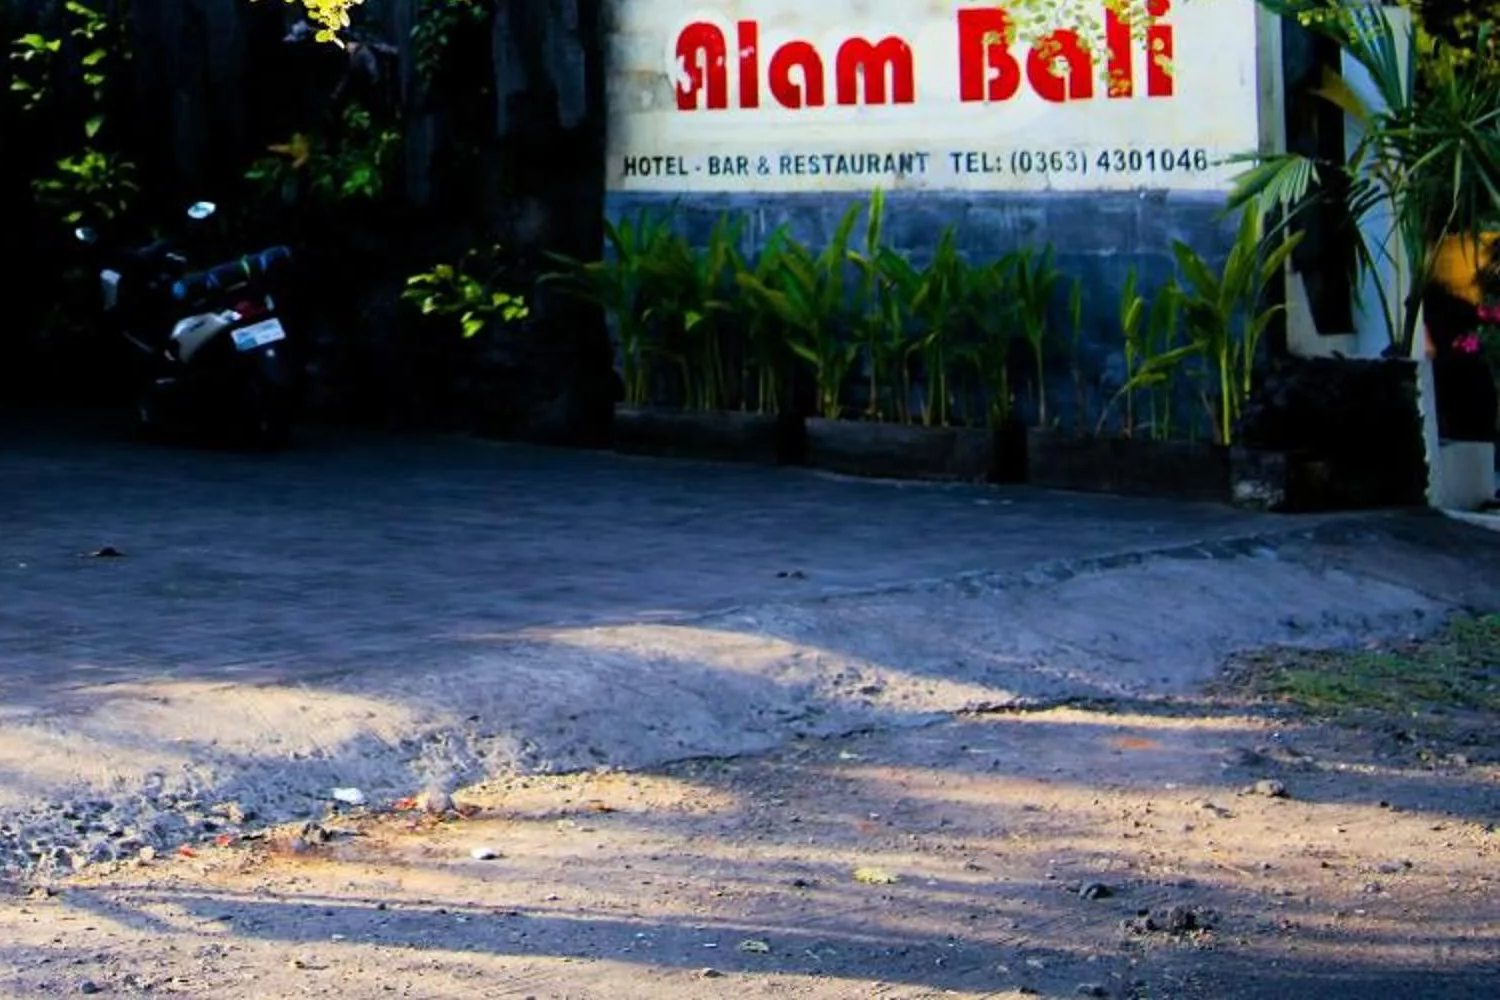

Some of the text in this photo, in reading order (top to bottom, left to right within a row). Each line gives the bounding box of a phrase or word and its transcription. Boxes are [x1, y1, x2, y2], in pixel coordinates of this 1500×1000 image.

[676, 21, 915, 110] Alam
[623, 155, 689, 177] HOTEL
[708, 155, 749, 177] BAR
[756, 157, 770, 176] &
[779, 152, 930, 176] RESTAURANT
[950, 151, 1002, 174] TEL:
[1010, 150, 1088, 175] (0363)
[1096, 149, 1209, 173] 4301046
